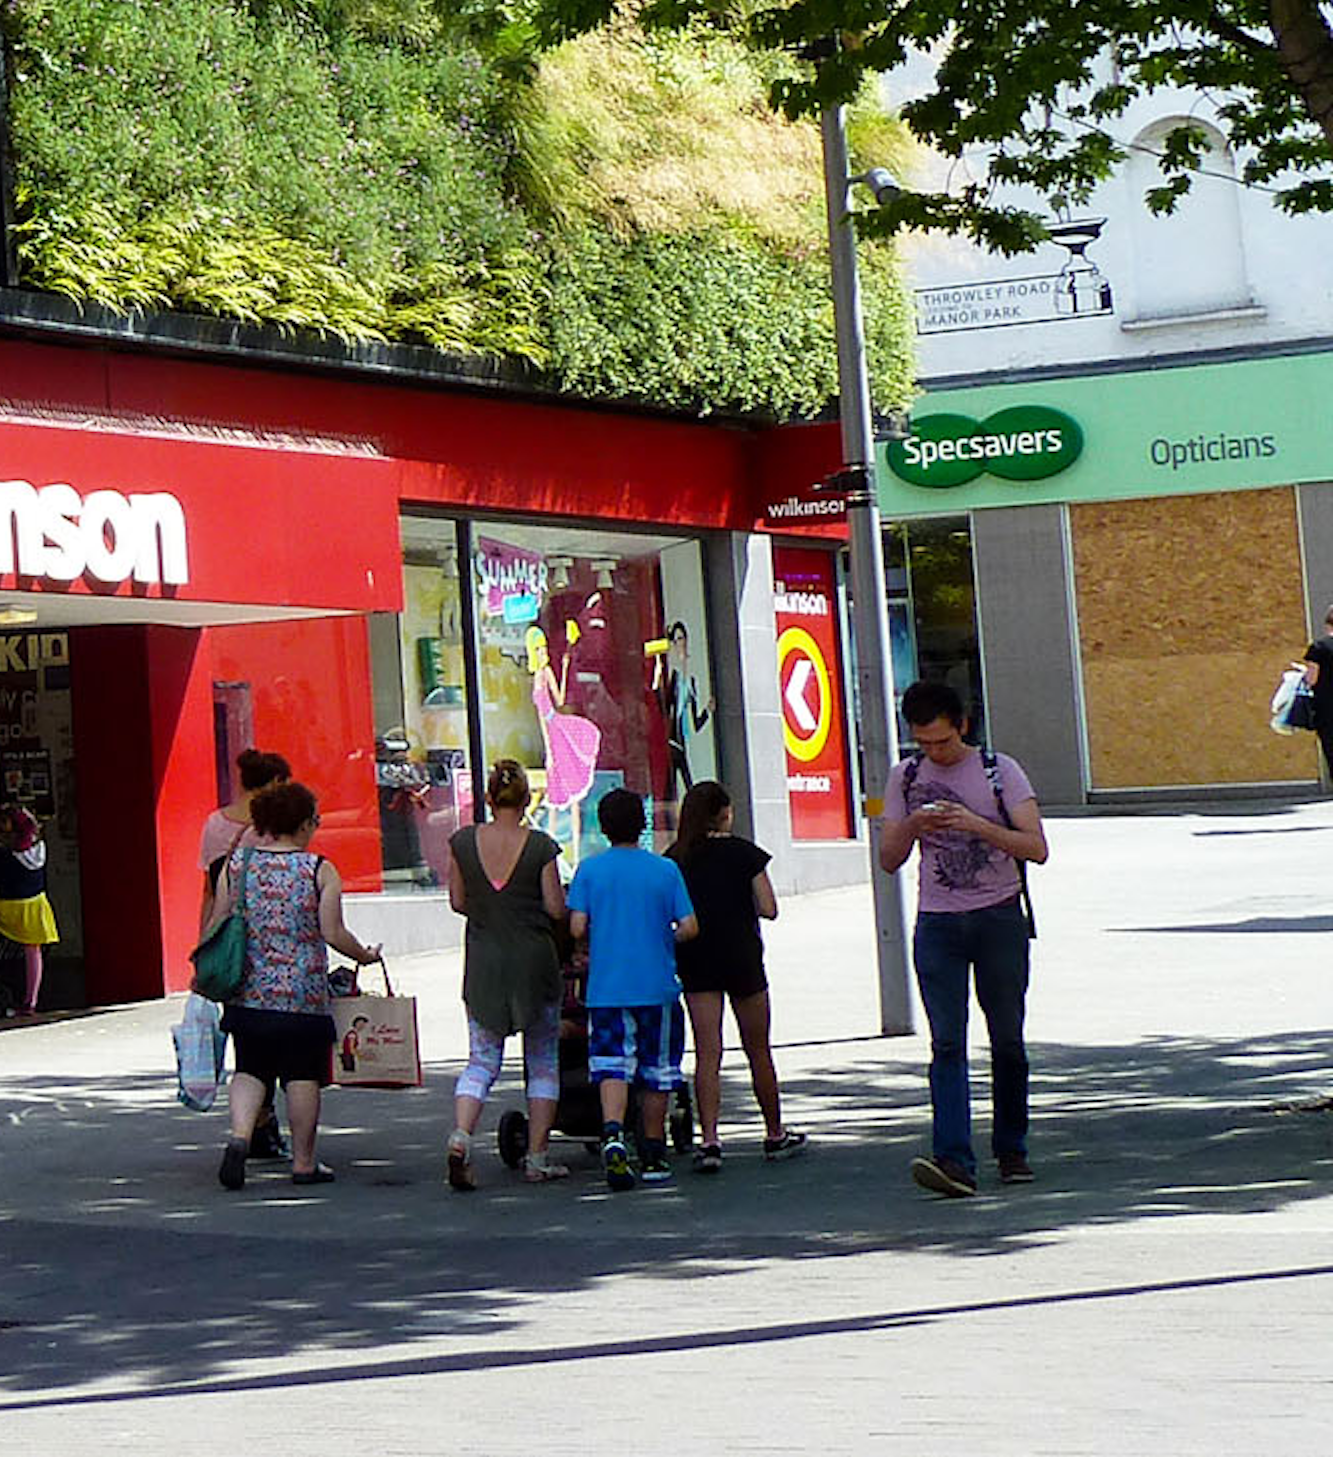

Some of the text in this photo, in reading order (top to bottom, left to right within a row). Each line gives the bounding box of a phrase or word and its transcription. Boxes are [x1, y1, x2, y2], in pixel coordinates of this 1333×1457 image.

[924, 281, 1050, 305] THROWLEY ROAD
[925, 305, 1022, 327] MANOR PARK
[902, 429, 1063, 469] Specsavers
[1151, 433, 1276, 471] Opticians
[476, 551, 549, 595] SUMMER
